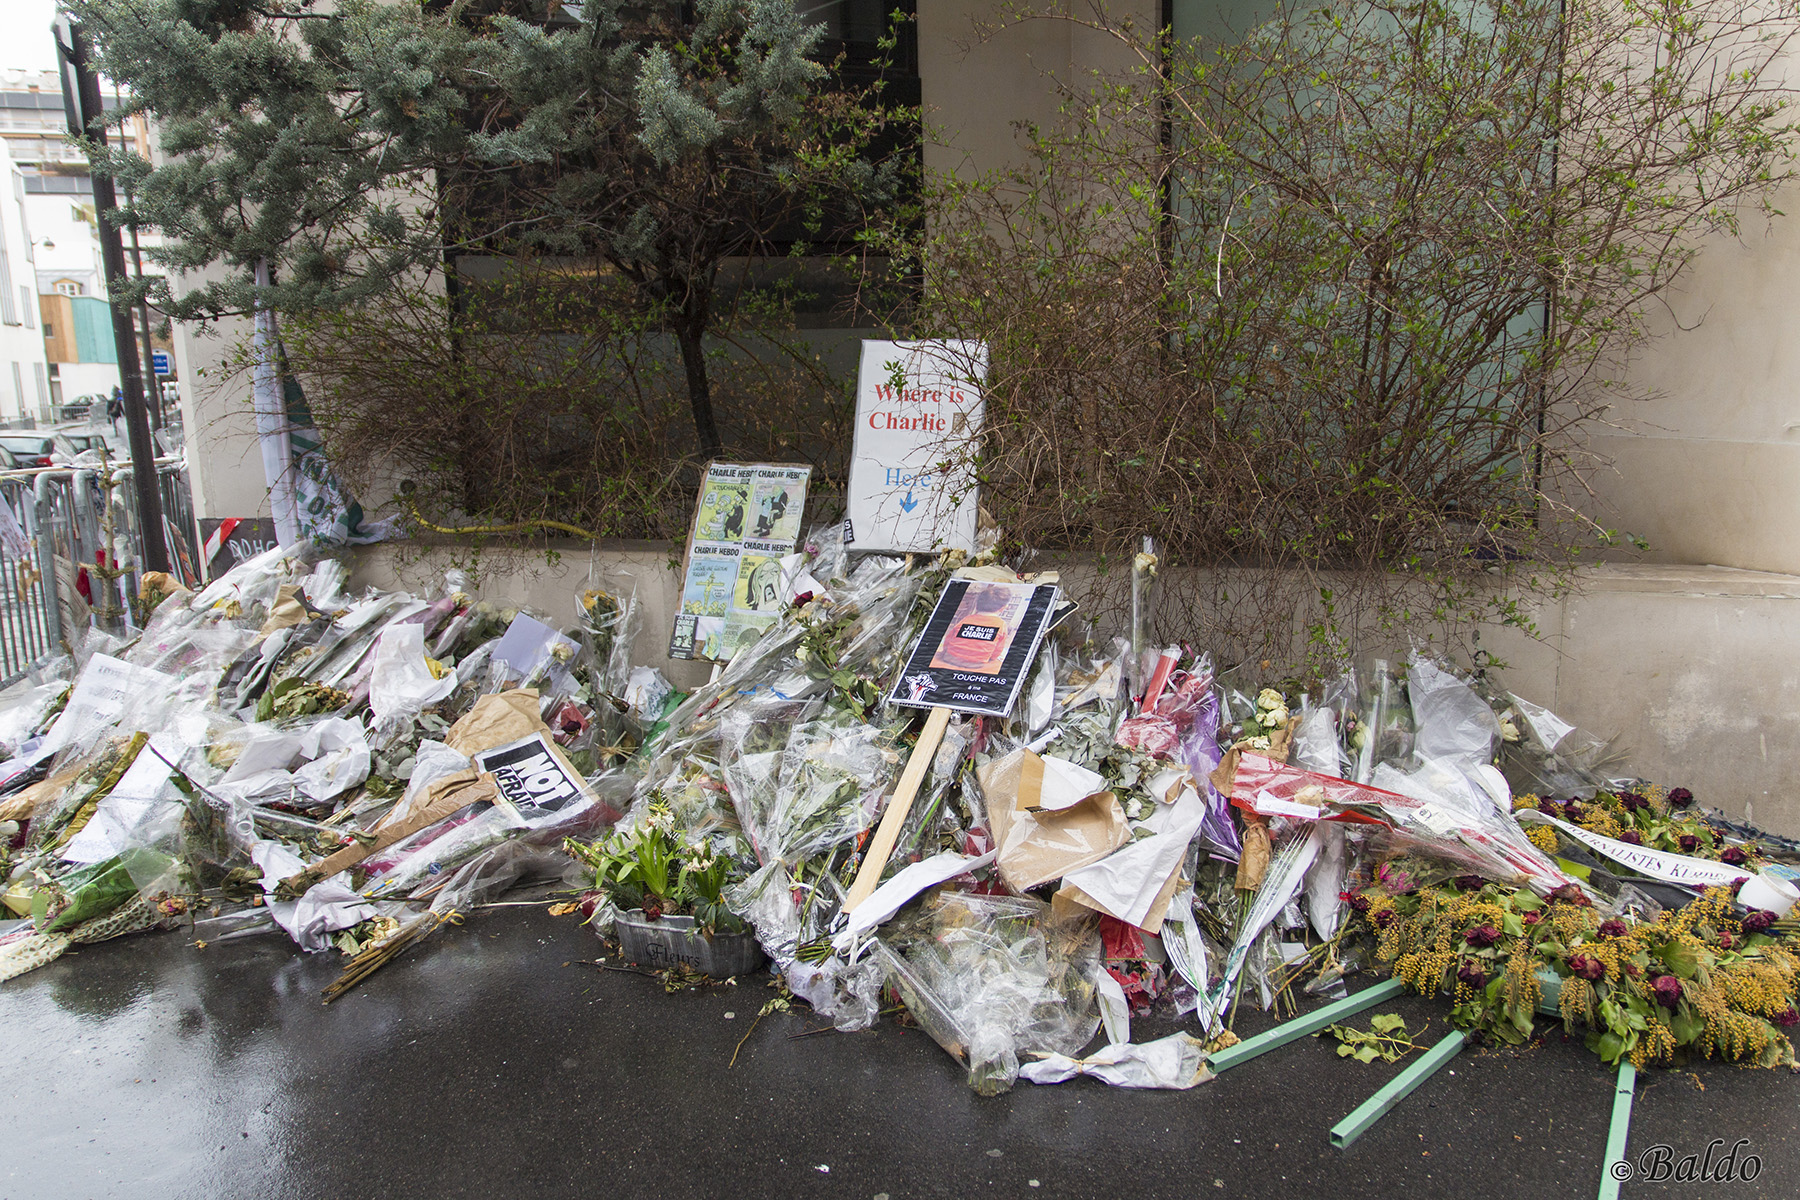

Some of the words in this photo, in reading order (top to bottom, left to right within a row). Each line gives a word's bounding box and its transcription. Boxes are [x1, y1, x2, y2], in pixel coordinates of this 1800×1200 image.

[874, 384, 942, 403] Where
[949, 385, 965, 404] is
[869, 411, 946, 431] Charlie
[708, 467, 737, 478] CHARLIE
[737, 469, 757, 479] HEB
[758, 469, 785, 479] CHARLIE
[785, 471, 808, 480] HEB
[884, 467, 932, 487] Here
[694, 545, 718, 555] CHARLIE
[718, 547, 740, 557] HEBDO
[743, 541, 770, 552] CHARLIE
[961, 630, 994, 640] CHARLIE
[975, 626, 995, 634] SUIS
[952, 673, 988, 684] TOUCHE
[988, 677, 1007, 686] PAS
[952, 692, 989, 703] FRANCE
[511, 751, 575, 805] NOT
[1564, 825, 1664, 872] JOURNALISTES
[645, 942, 700, 967] Fleurs
